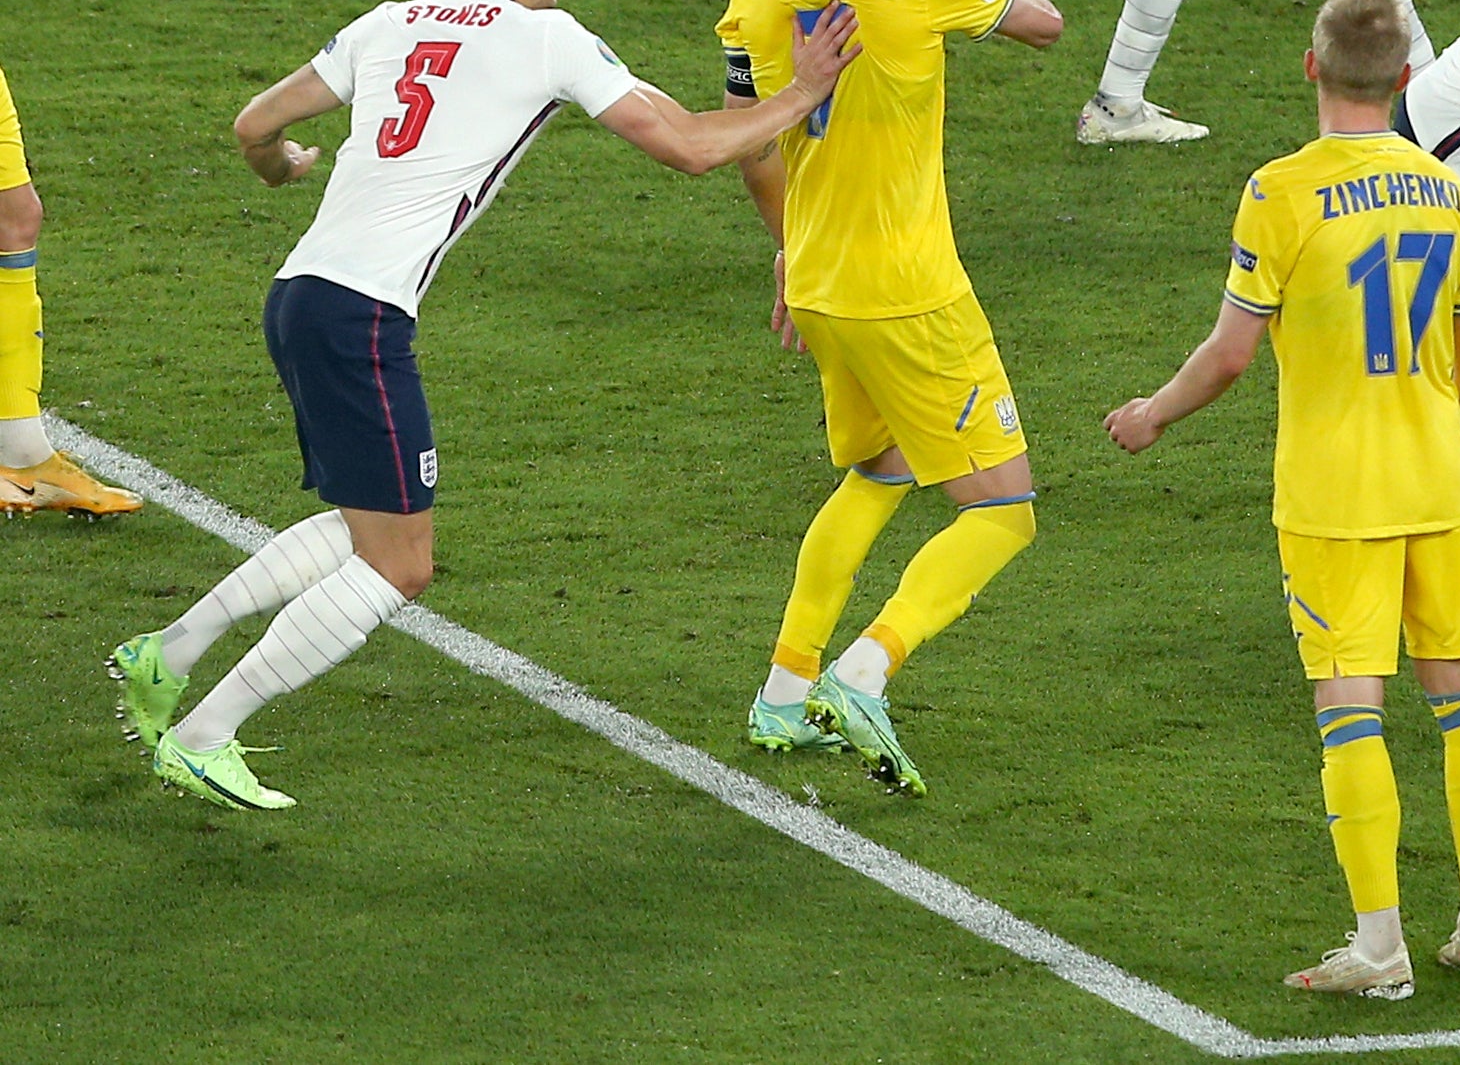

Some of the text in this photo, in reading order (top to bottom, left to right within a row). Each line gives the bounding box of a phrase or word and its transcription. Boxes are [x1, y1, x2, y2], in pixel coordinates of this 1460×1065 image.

[405, 3, 502, 27] STONES
[376, 41, 462, 159] 5
[1346, 231, 1457, 377] 17
